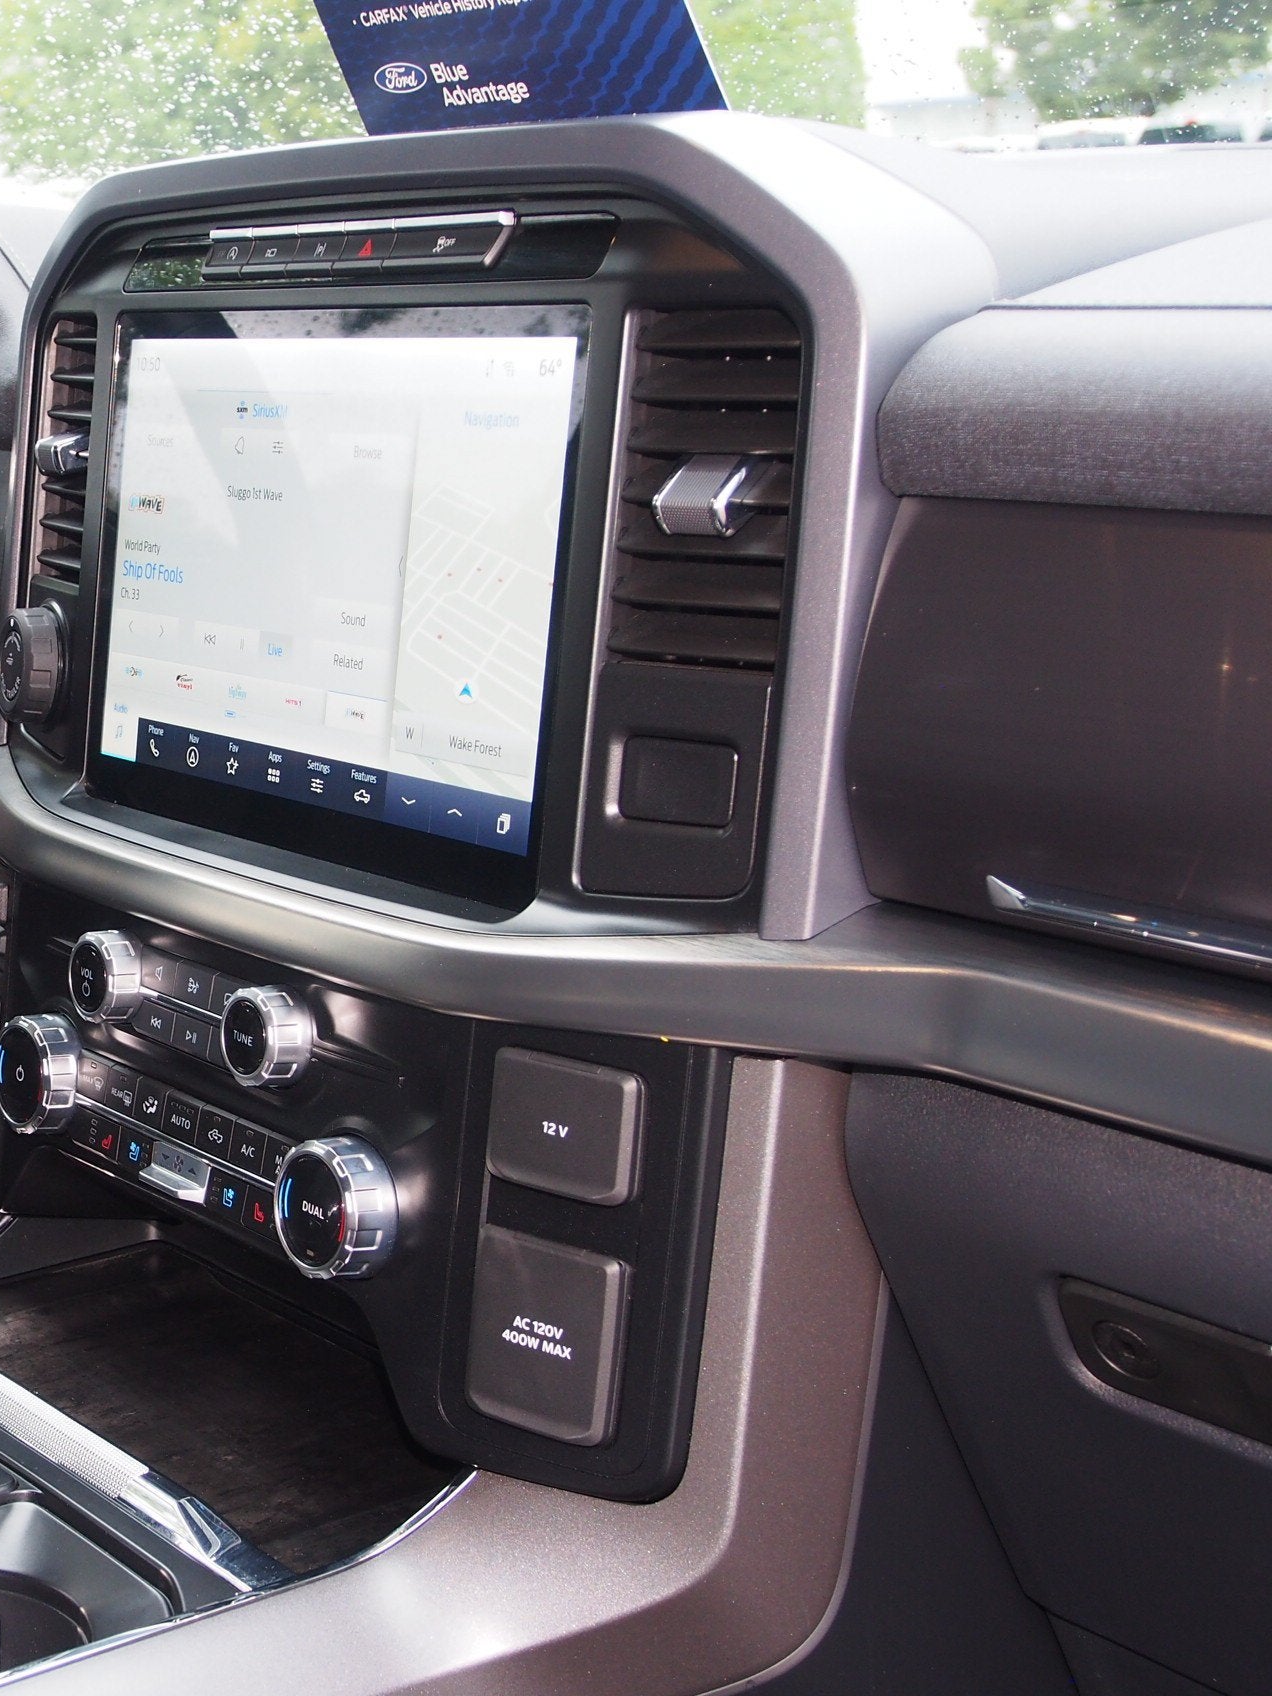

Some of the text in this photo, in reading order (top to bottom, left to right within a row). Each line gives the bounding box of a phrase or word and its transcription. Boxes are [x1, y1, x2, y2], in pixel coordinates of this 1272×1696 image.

[409, 0, 453, 19] Vehicle
[453, 0, 495, 13] History
[385, 67, 418, 89] Ford
[430, 62, 469, 84] Blue
[442, 81, 530, 107] Advantage
[464, 411, 520, 429] Navigation
[147, 434, 174, 449] Sources
[353, 445, 383, 460] Browse
[227, 485, 251, 502] Sluggo
[263, 488, 283, 502] Wave
[124, 538, 161, 555] World Party
[123, 560, 184, 584] Ship Of Fools
[132, 588, 140, 600] 33
[341, 611, 366, 627] Sound
[268, 643, 283, 657] Live
[333, 653, 364, 671] Related
[148, 725, 164, 737] Phone
[189, 733, 200, 744] Nav
[229, 742, 240, 753] Fav
[406, 726, 502, 758] W Wake Forest
[268, 751, 283, 764] Apps
[307, 759, 330, 775] Settings
[351, 769, 377, 784] Features
[81, 966, 94, 981] VOL
[233, 1029, 254, 1047] TUNE
[111, 1087, 124, 1099] REAR
[170, 1114, 191, 1130] AUTO
[542, 1120, 569, 1138] 12 V
[240, 1143, 256, 1158] A/C
[301, 1200, 325, 1220] DUAL
[512, 1315, 564, 1340] AC 120V
[501, 1328, 572, 1360] 400W MAX
